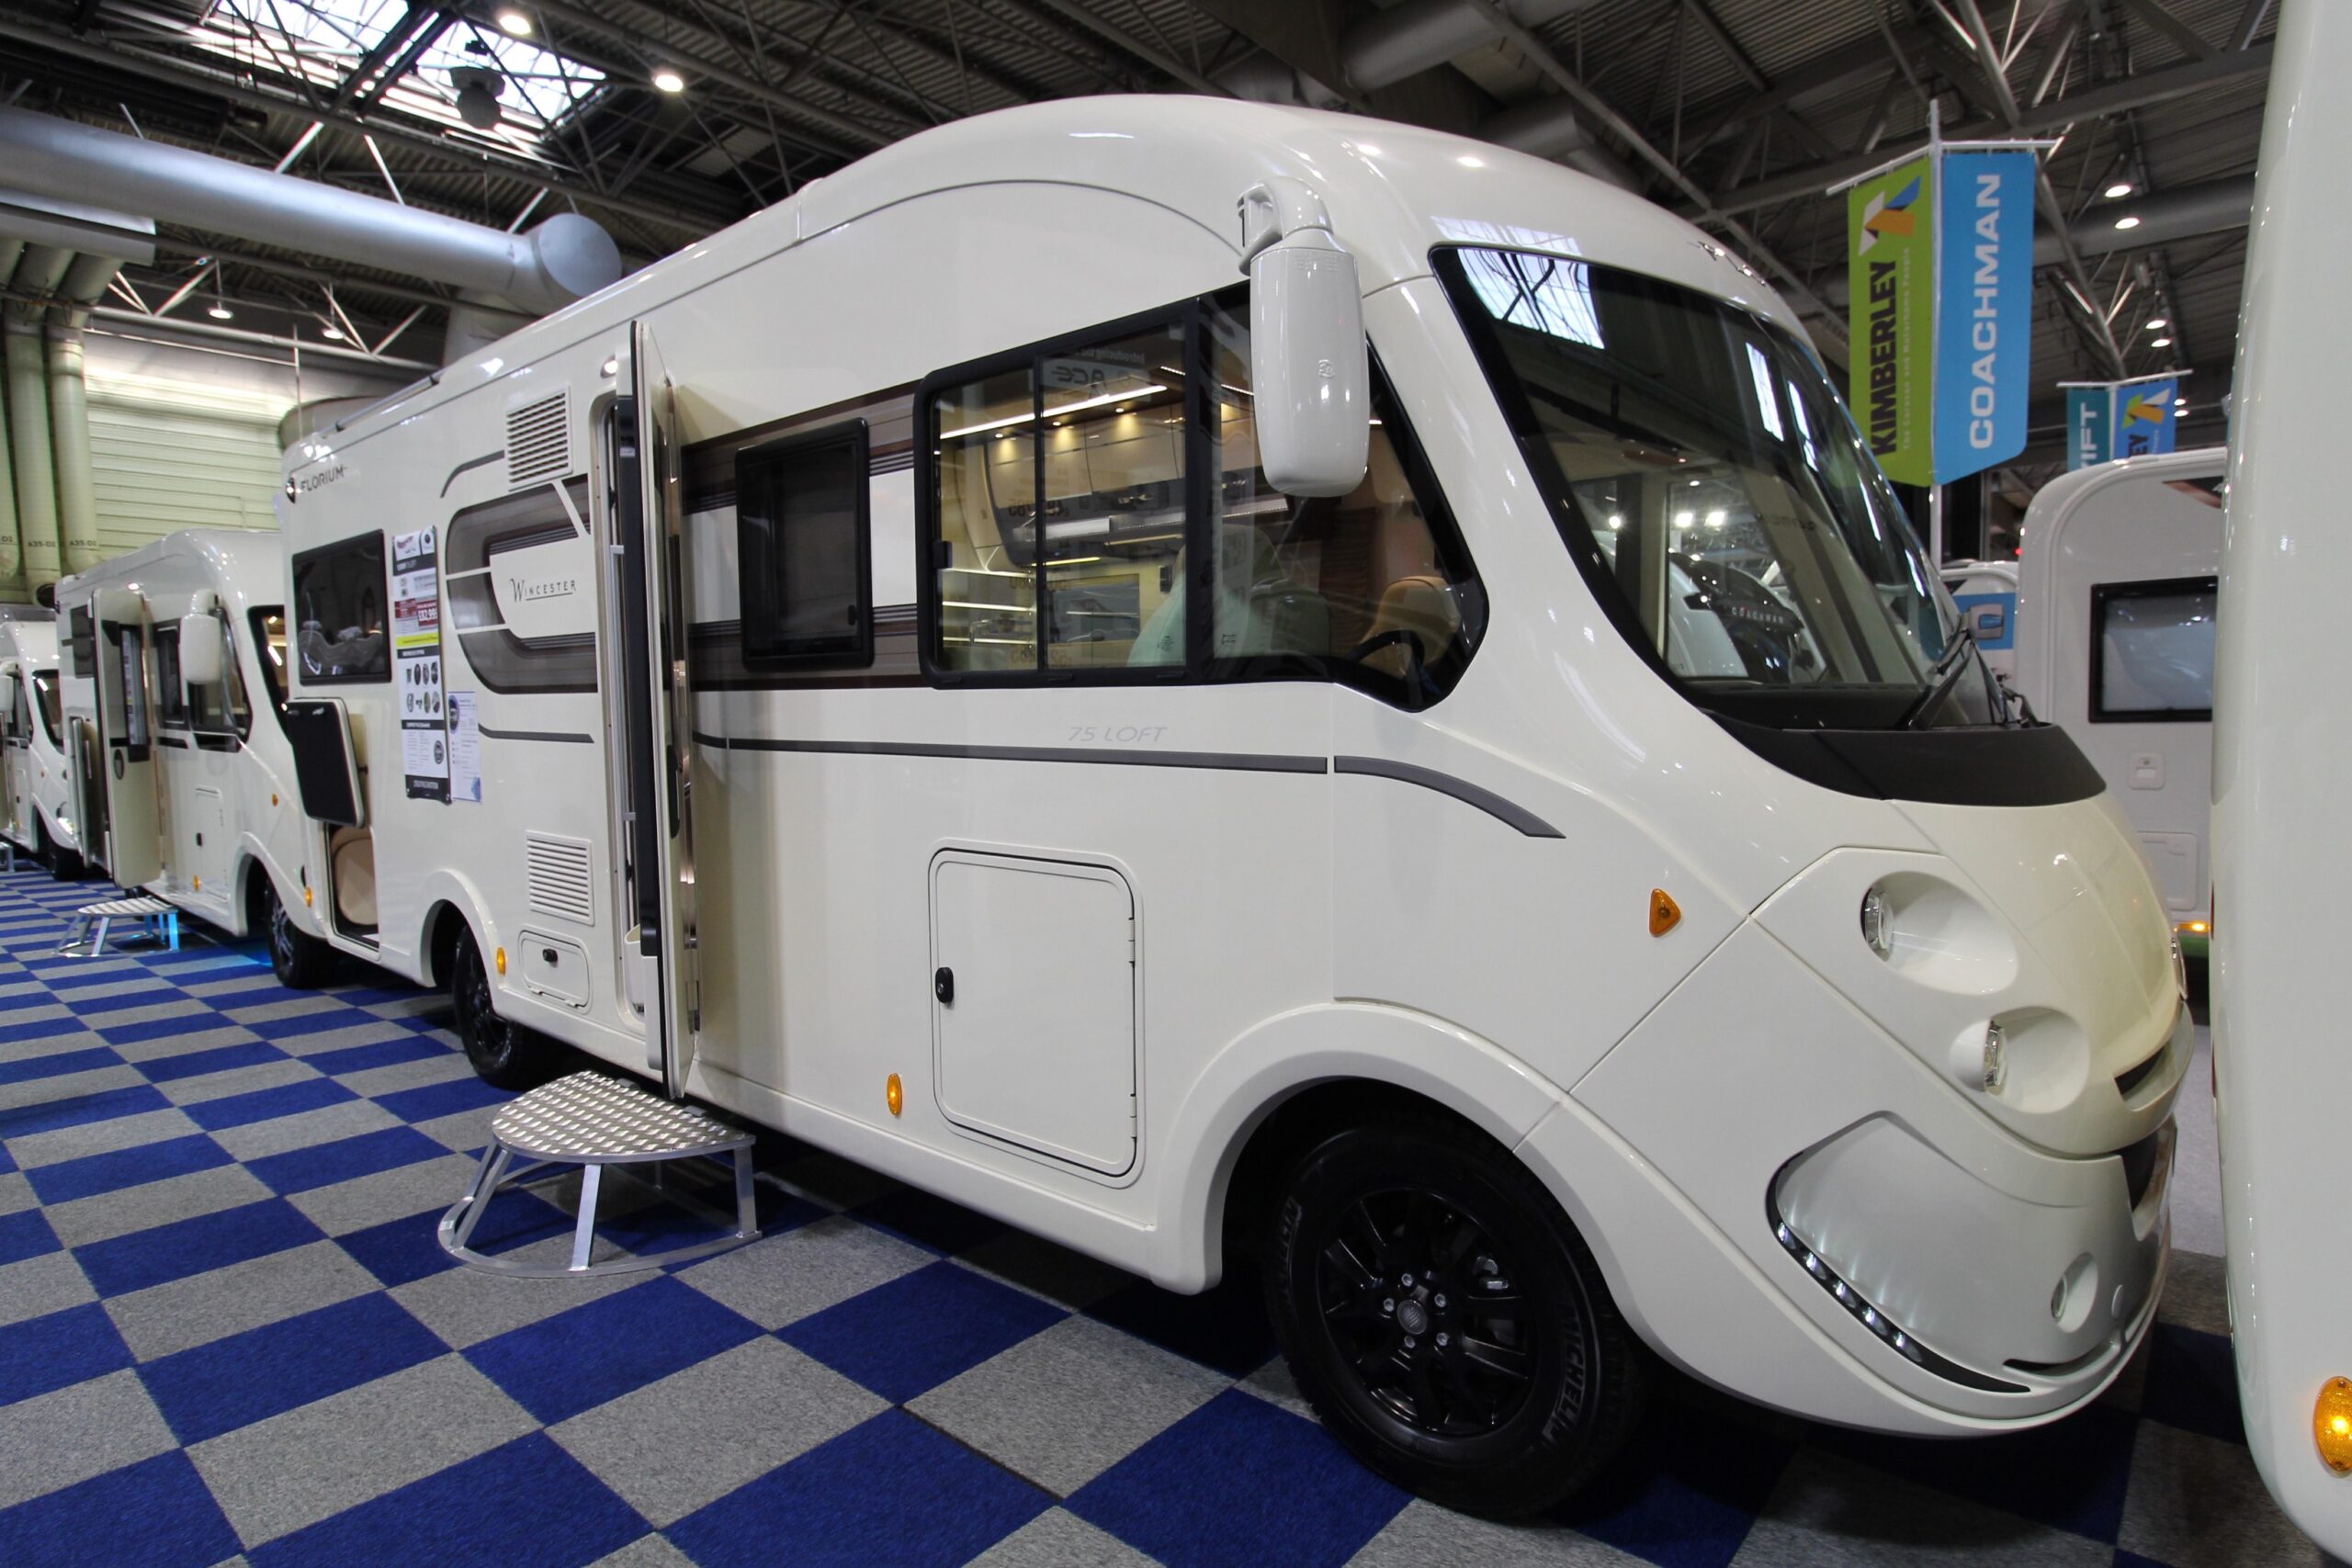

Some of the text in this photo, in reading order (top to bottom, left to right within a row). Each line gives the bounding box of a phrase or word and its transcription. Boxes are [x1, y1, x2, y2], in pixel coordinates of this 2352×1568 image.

[1970, 175, 2001, 448] COACHMAN
[1870, 260, 1897, 457] KIMBERLEY
[2080, 402, 2098, 468] IFT
[300, 465, 345, 491] FLORIUM
[1731, 606, 1784, 625] COACHMAN
[1067, 727, 1169, 743] 75 LOFT
[1541, 1302, 1587, 1449] MICHELIN
